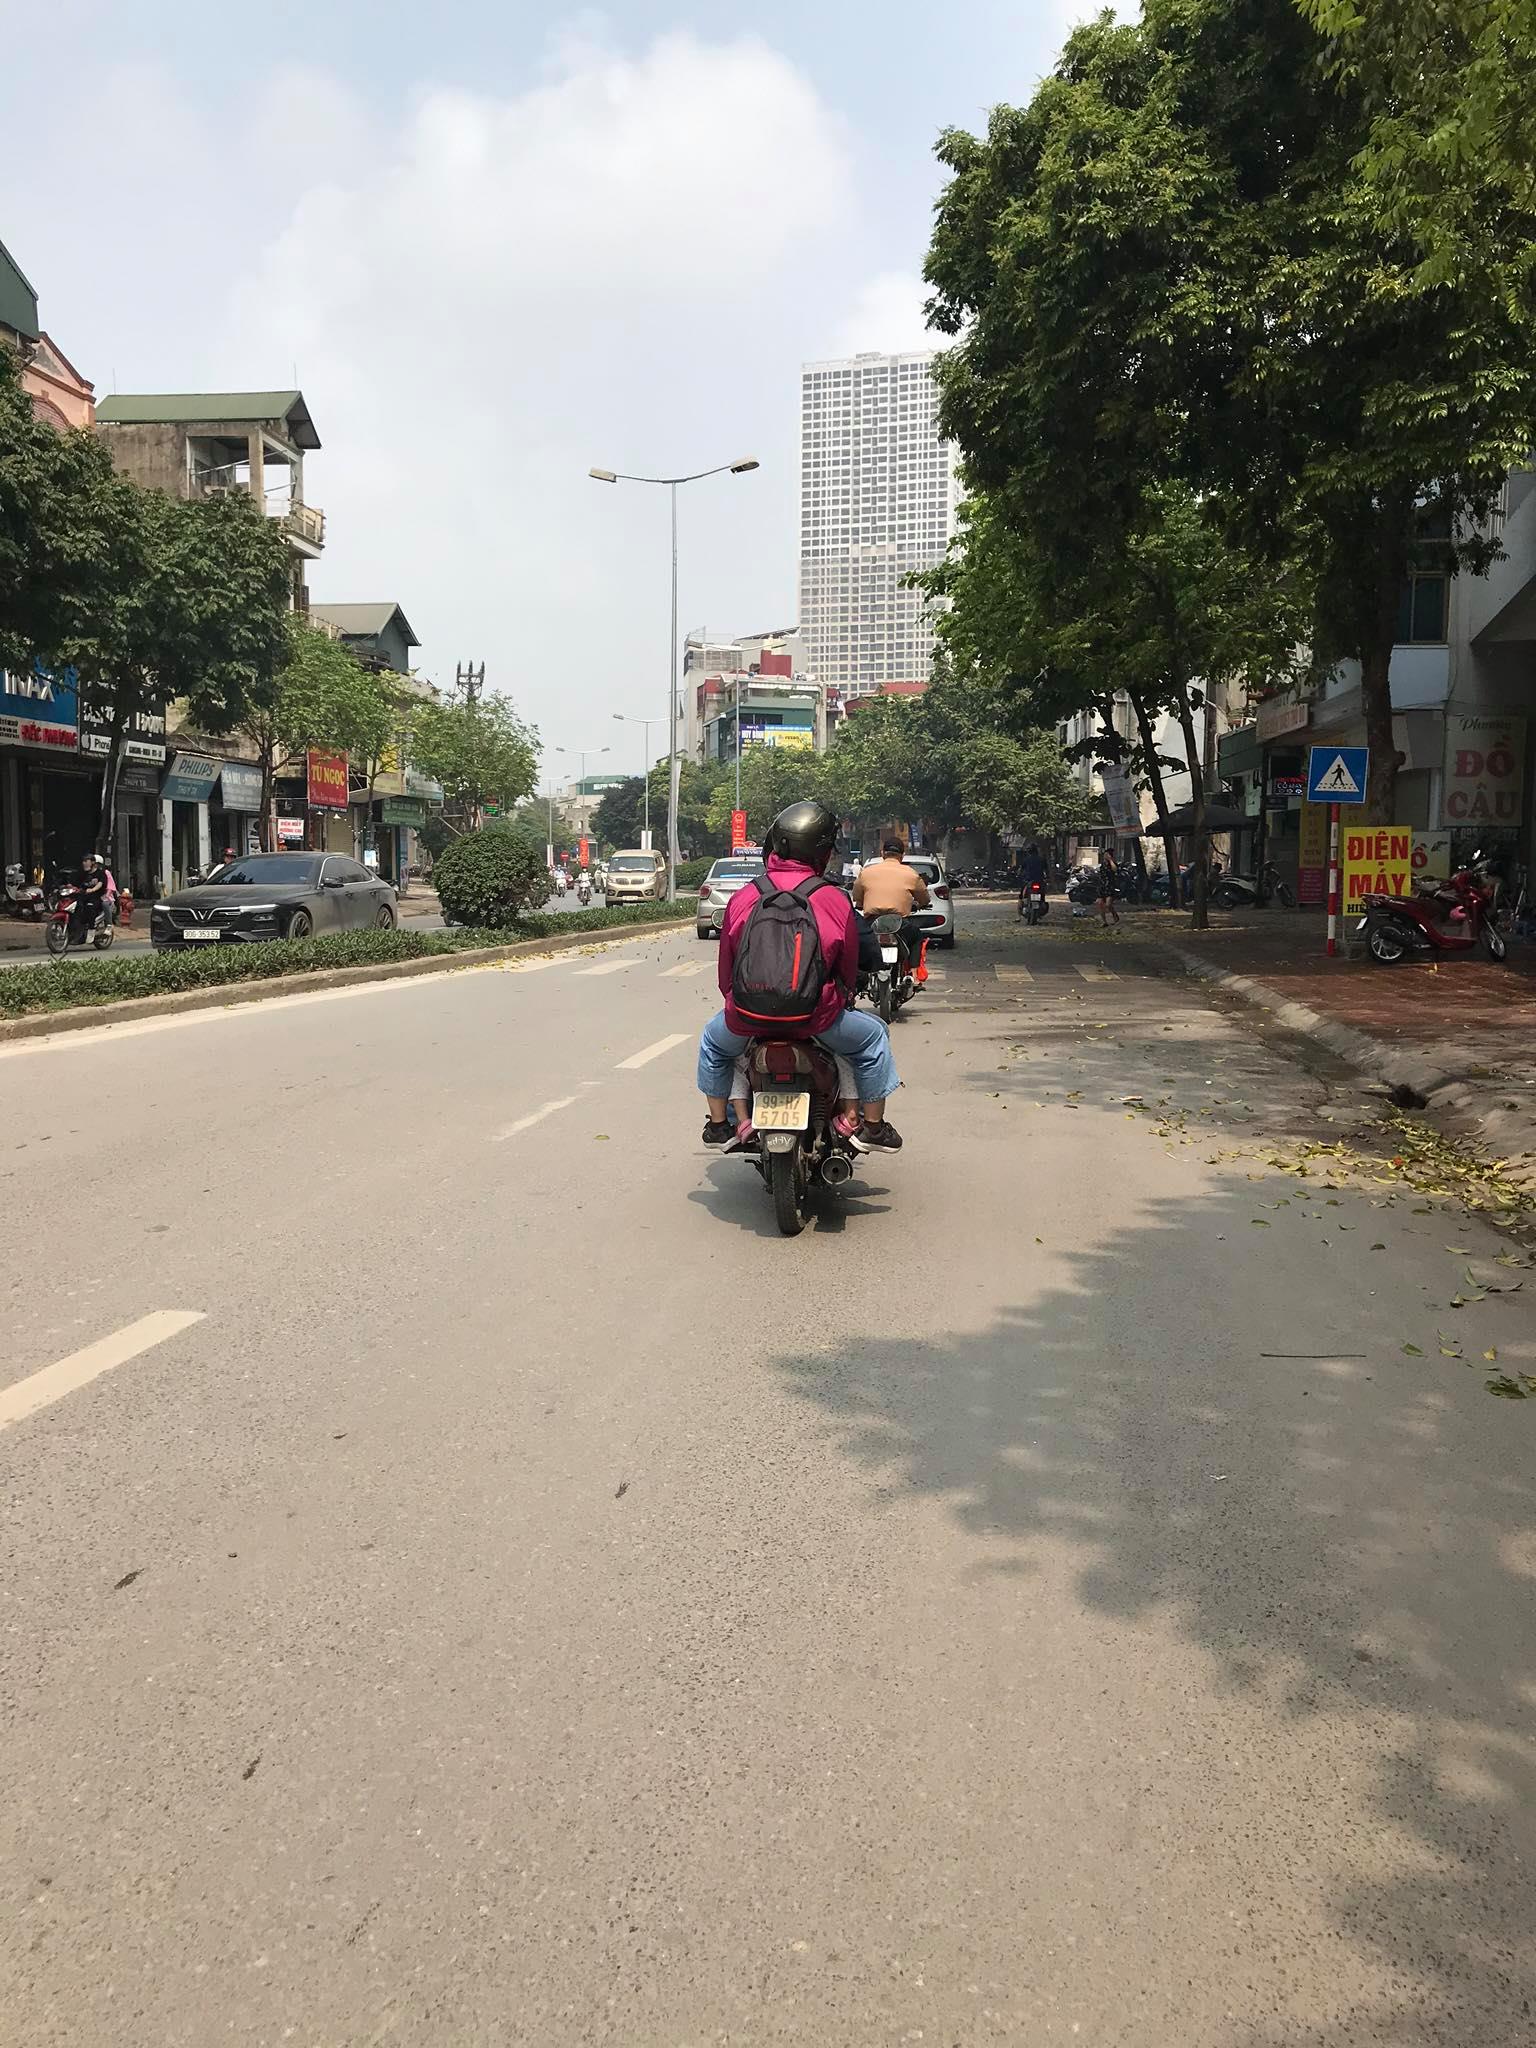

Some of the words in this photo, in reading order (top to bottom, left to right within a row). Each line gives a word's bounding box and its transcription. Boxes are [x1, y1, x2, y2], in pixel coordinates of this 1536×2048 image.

[178, 758, 215, 777] PHILIPS
[324, 767, 345, 788] NGỌC
[1447, 782, 1519, 818] CÂU
[1347, 831, 1409, 866] ĐIỆN
[1349, 868, 1407, 898] MÁY
[760, 1111, 800, 1126] 5705
